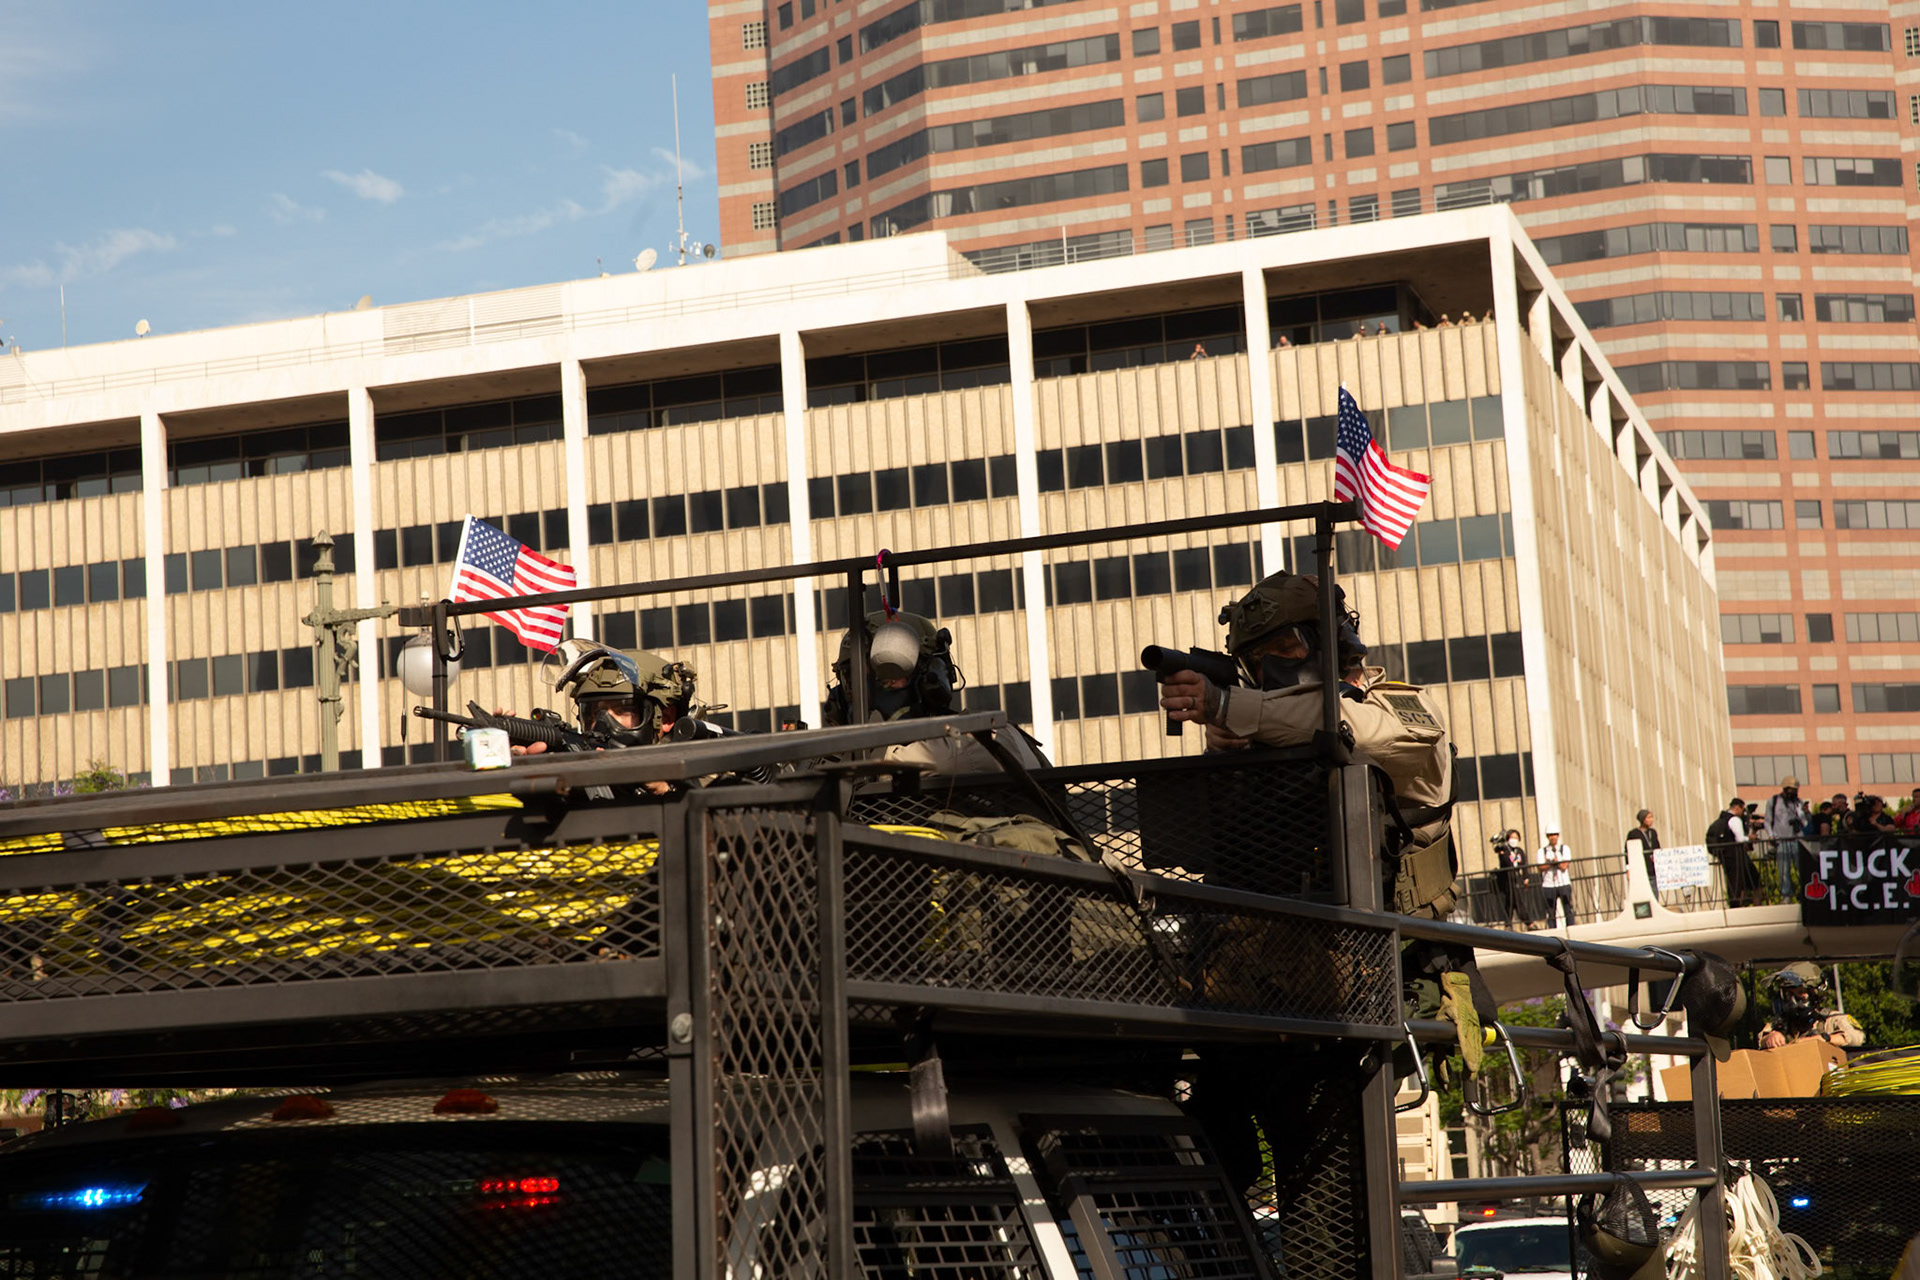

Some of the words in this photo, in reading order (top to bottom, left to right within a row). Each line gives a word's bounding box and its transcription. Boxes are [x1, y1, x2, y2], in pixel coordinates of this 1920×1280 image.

[1398, 711, 1435, 726] SCT
[1819, 848, 1912, 880] FUCK
[1829, 882, 1910, 911] I.C.E.
